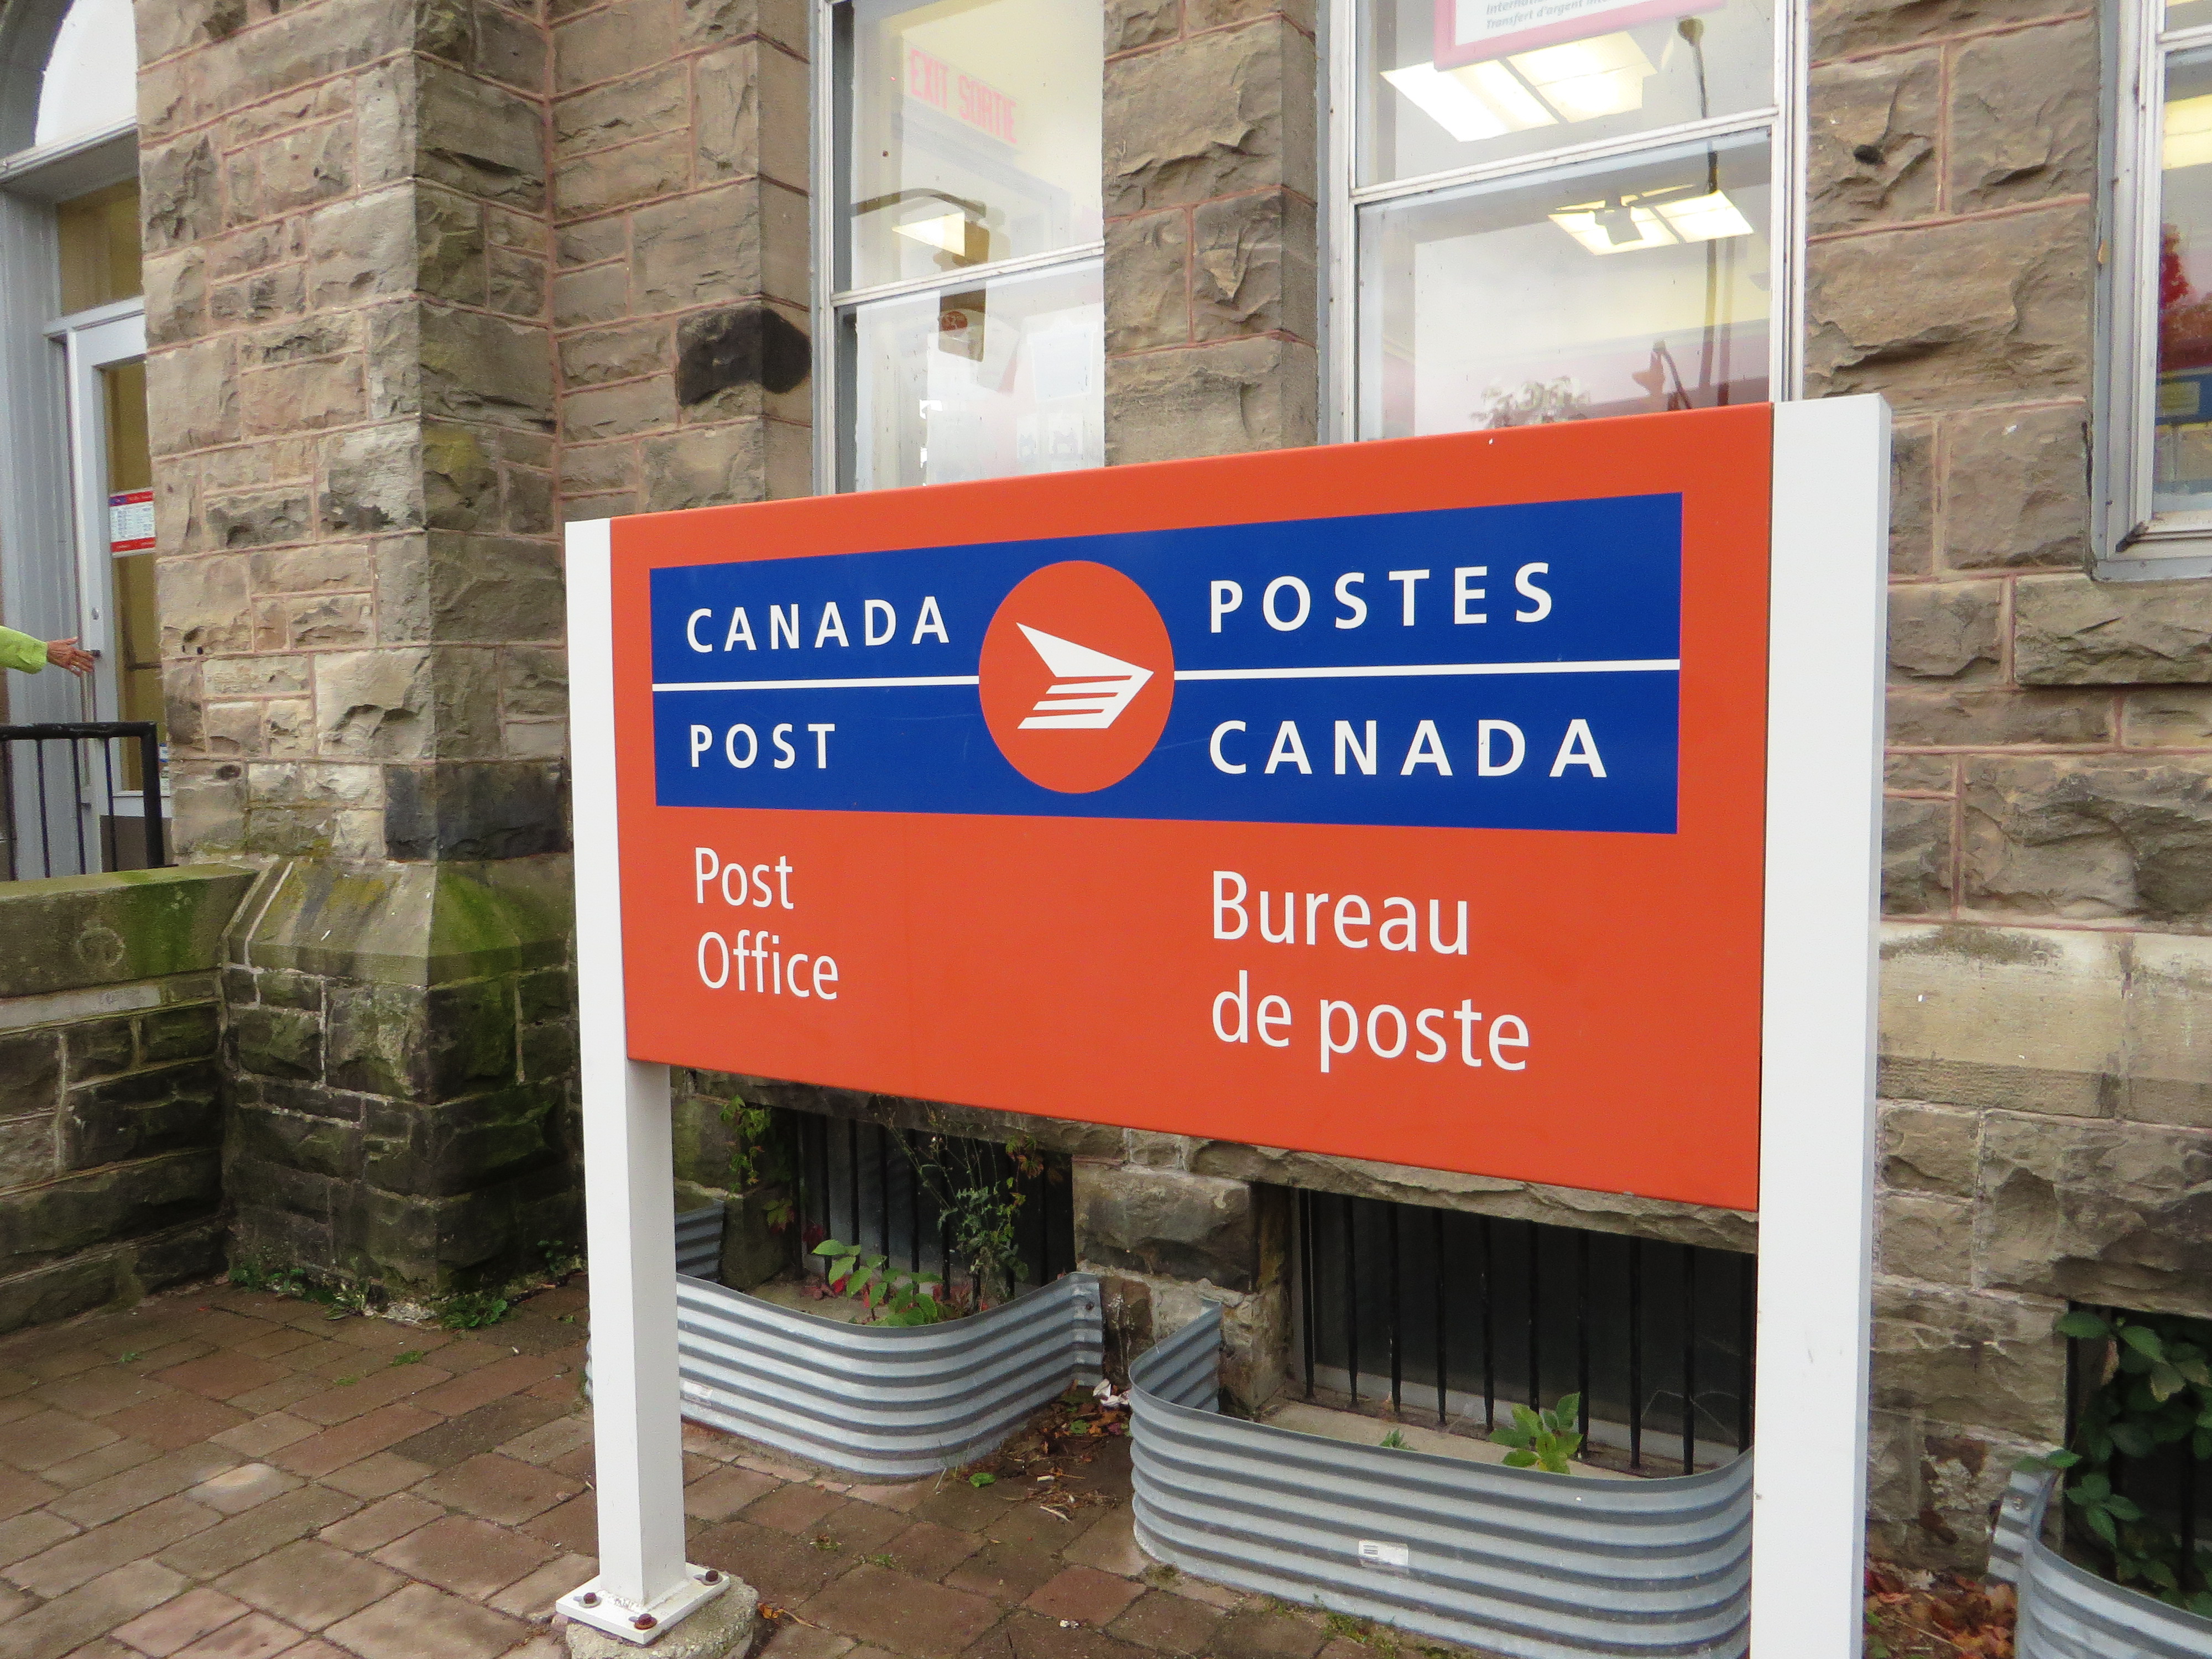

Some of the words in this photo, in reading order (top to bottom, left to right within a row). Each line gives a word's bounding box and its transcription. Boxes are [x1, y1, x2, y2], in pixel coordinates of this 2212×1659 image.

[1486, 10, 1533, 29] Transfert
[1536, 0, 1583, 15] d'argent
[910, 48, 950, 109] EXIT
[957, 74, 1018, 144] SORTIE
[686, 596, 950, 654] CANADA
[1210, 561, 1553, 634] POSTES
[689, 722, 837, 770] POST
[1209, 718, 1608, 779] CANADA
[694, 847, 795, 910] Post
[1212, 870, 1469, 956] Bureau
[697, 928, 839, 1001] Office
[1212, 969, 1292, 1048] de
[1319, 998, 1530, 1074] poste
